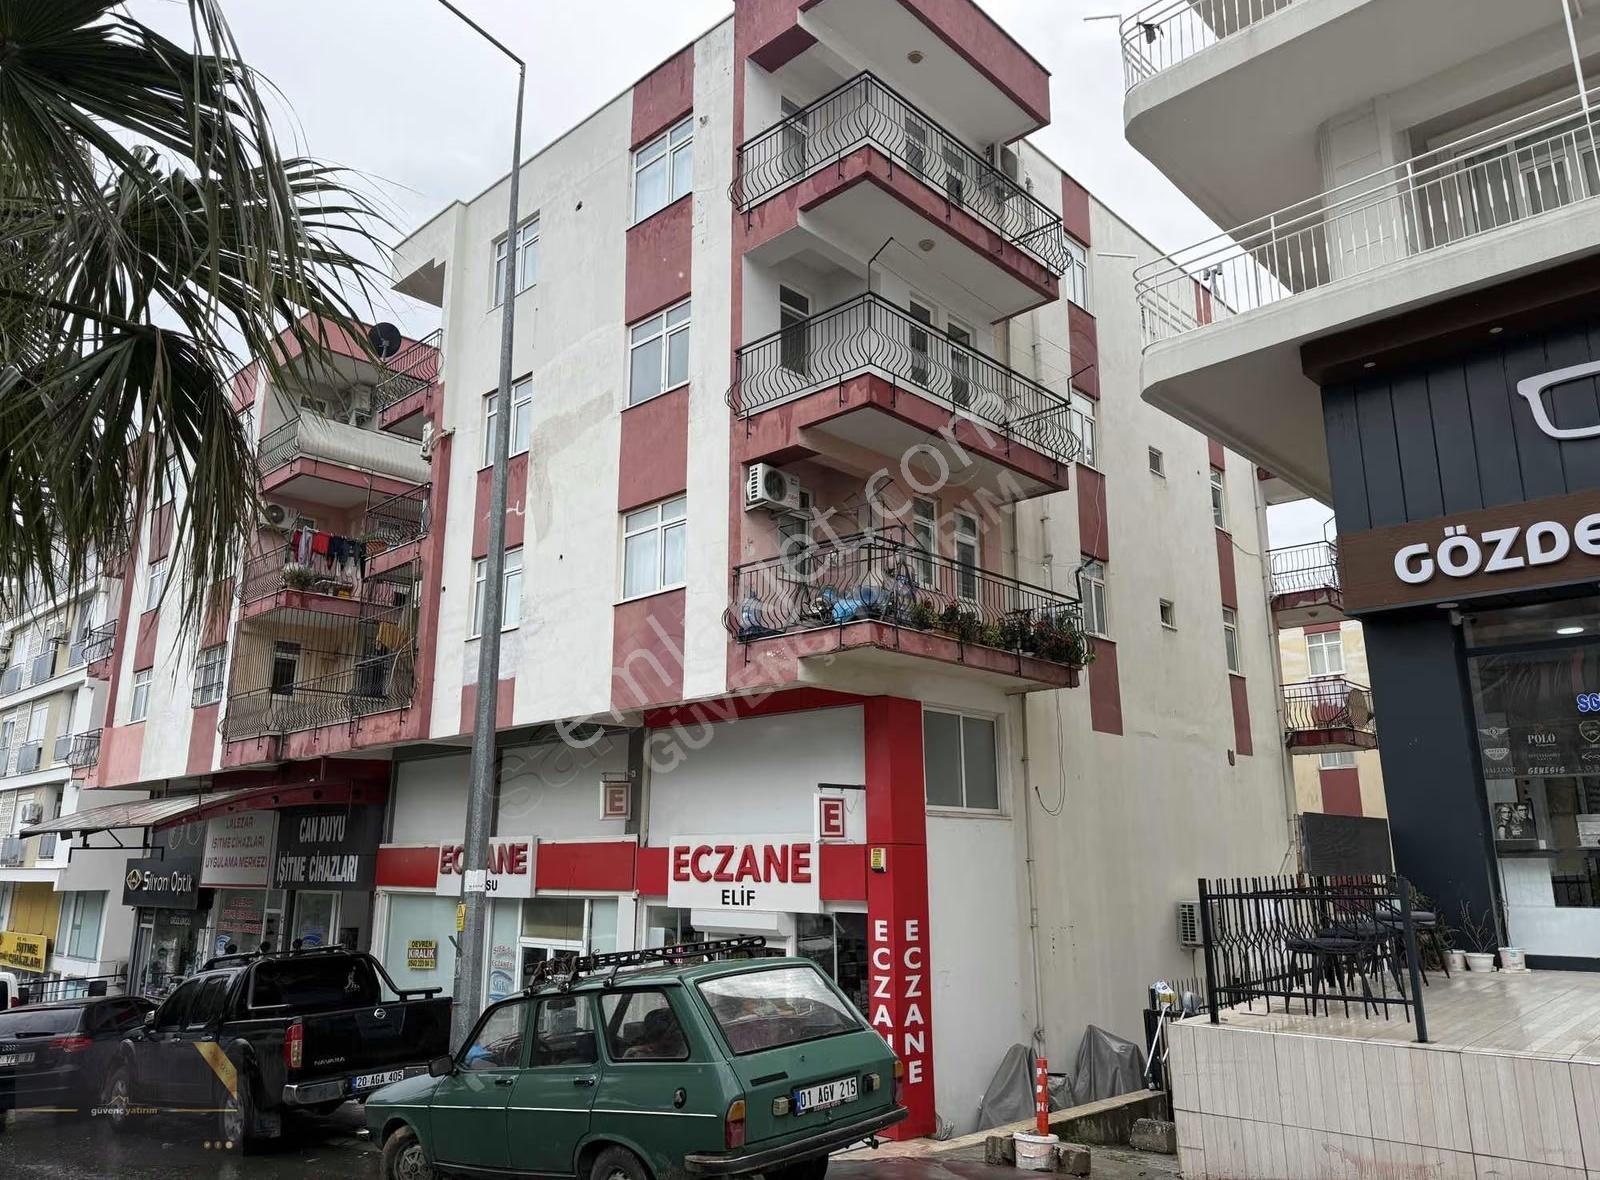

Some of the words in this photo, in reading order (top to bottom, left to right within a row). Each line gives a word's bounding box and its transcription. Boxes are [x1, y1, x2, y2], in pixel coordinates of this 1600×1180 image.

[1394, 513, 1600, 584] GÖZDE
[1576, 693, 1600, 712] SG
[608, 789, 625, 813] E
[318, 814, 347, 843] DUYU
[824, 803, 841, 833] E
[308, 850, 359, 883] CİHAZLARI
[440, 843, 528, 875] ECANE
[673, 843, 811, 883] ECZANE
[721, 885, 756, 906] ELİF
[872, 919, 894, 1049] ECZA
[903, 919, 925, 1084] ECZANE
[357, 1076, 367, 1087] 20
[370, 1074, 385, 1085] AGA
[800, 1090, 812, 1108] 01
[818, 1084, 834, 1103] AGV
[840, 1079, 856, 1097] 215
